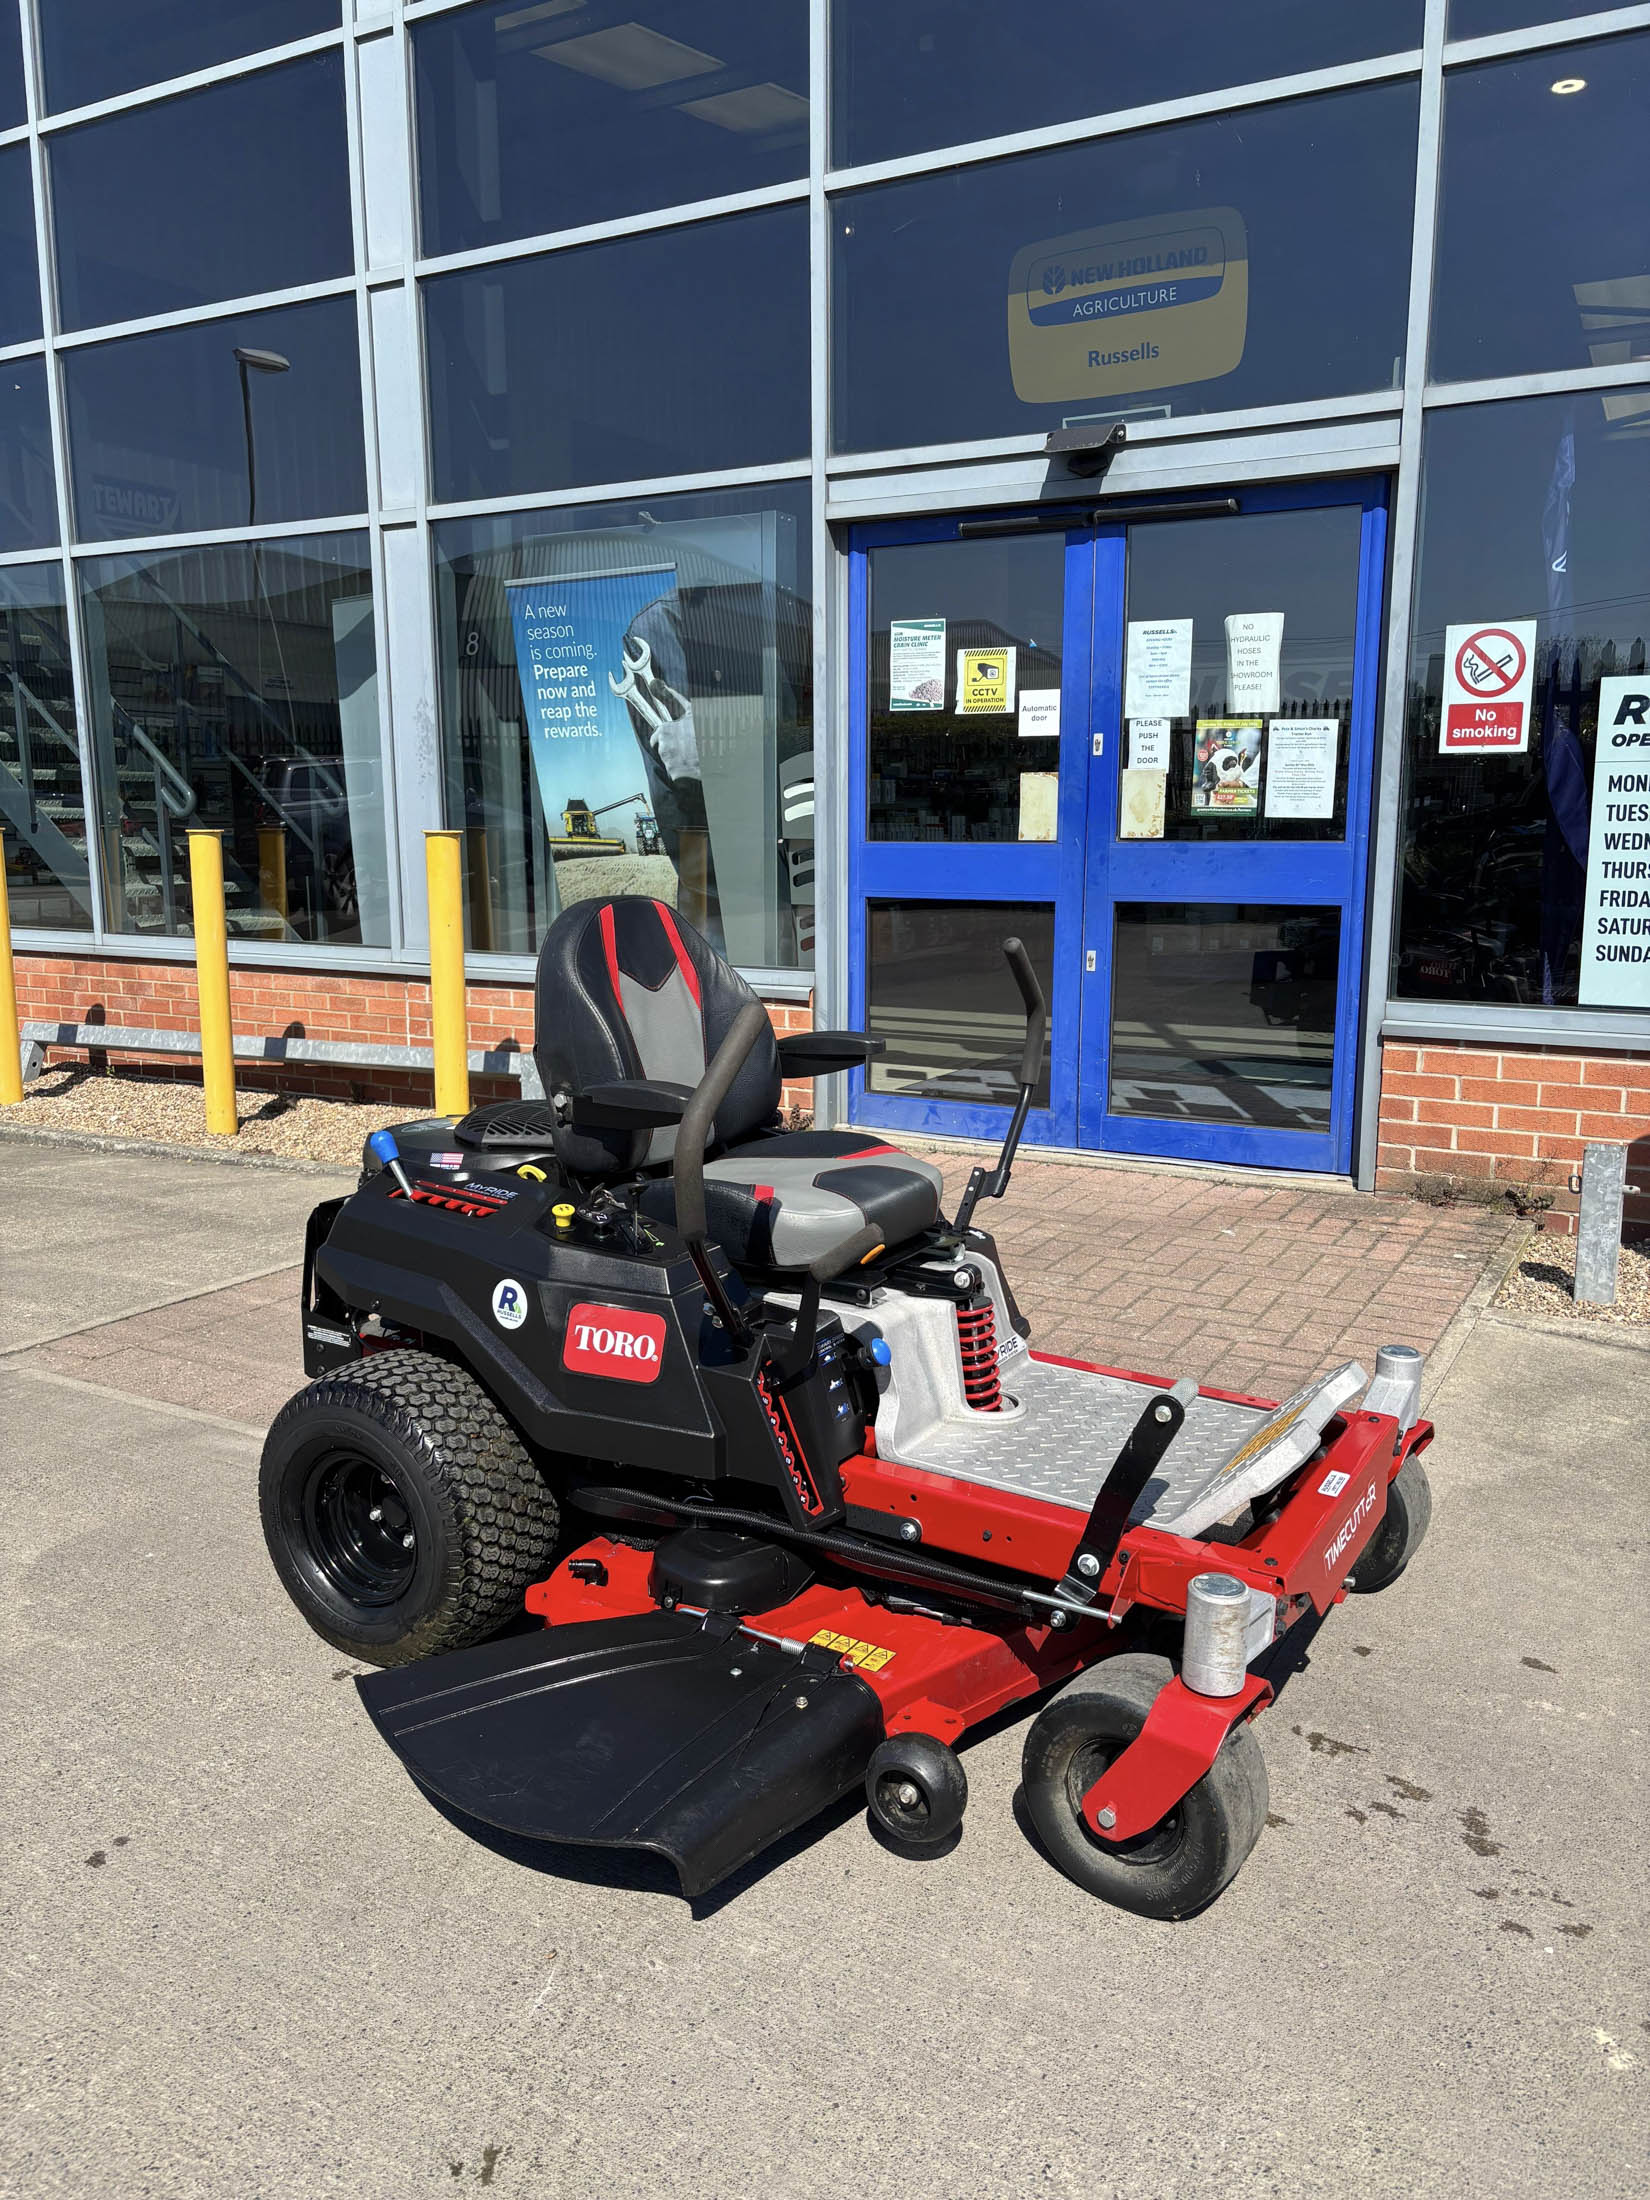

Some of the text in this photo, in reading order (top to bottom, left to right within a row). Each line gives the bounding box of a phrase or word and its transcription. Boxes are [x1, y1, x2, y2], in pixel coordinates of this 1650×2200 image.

[1070, 246, 1208, 287] NEW HOLLAND
[1072, 286, 1177, 317] AGRICULTURE
[1087, 341, 1160, 368] Russells
[525, 604, 567, 620] A new
[527, 624, 574, 640] season
[1142, 628, 1175, 636] RUSSELLS
[1231, 634, 1270, 643] HYDRAULIC
[530, 641, 597, 660] is coming.
[1237, 647, 1261, 655] HOSES
[1245, 659, 1259, 667] THE
[533, 664, 588, 682] Prepare
[1231, 671, 1273, 679] SHOWROOM
[537, 680, 596, 700] now and
[972, 688, 998, 697] CCTV
[541, 701, 598, 721] reap the
[1022, 705, 1057, 713] Automatic
[1475, 708, 1497, 721] No
[544, 721, 602, 739] rewards.
[1136, 719, 1163, 727] PLEASE
[1452, 724, 1517, 740] smoking
[1607, 774, 1650, 793] MON
[1602, 861, 1650, 879] THUR
[498, 1286, 518, 1312] R
[497, 1309, 522, 1320] RUSSELLS
